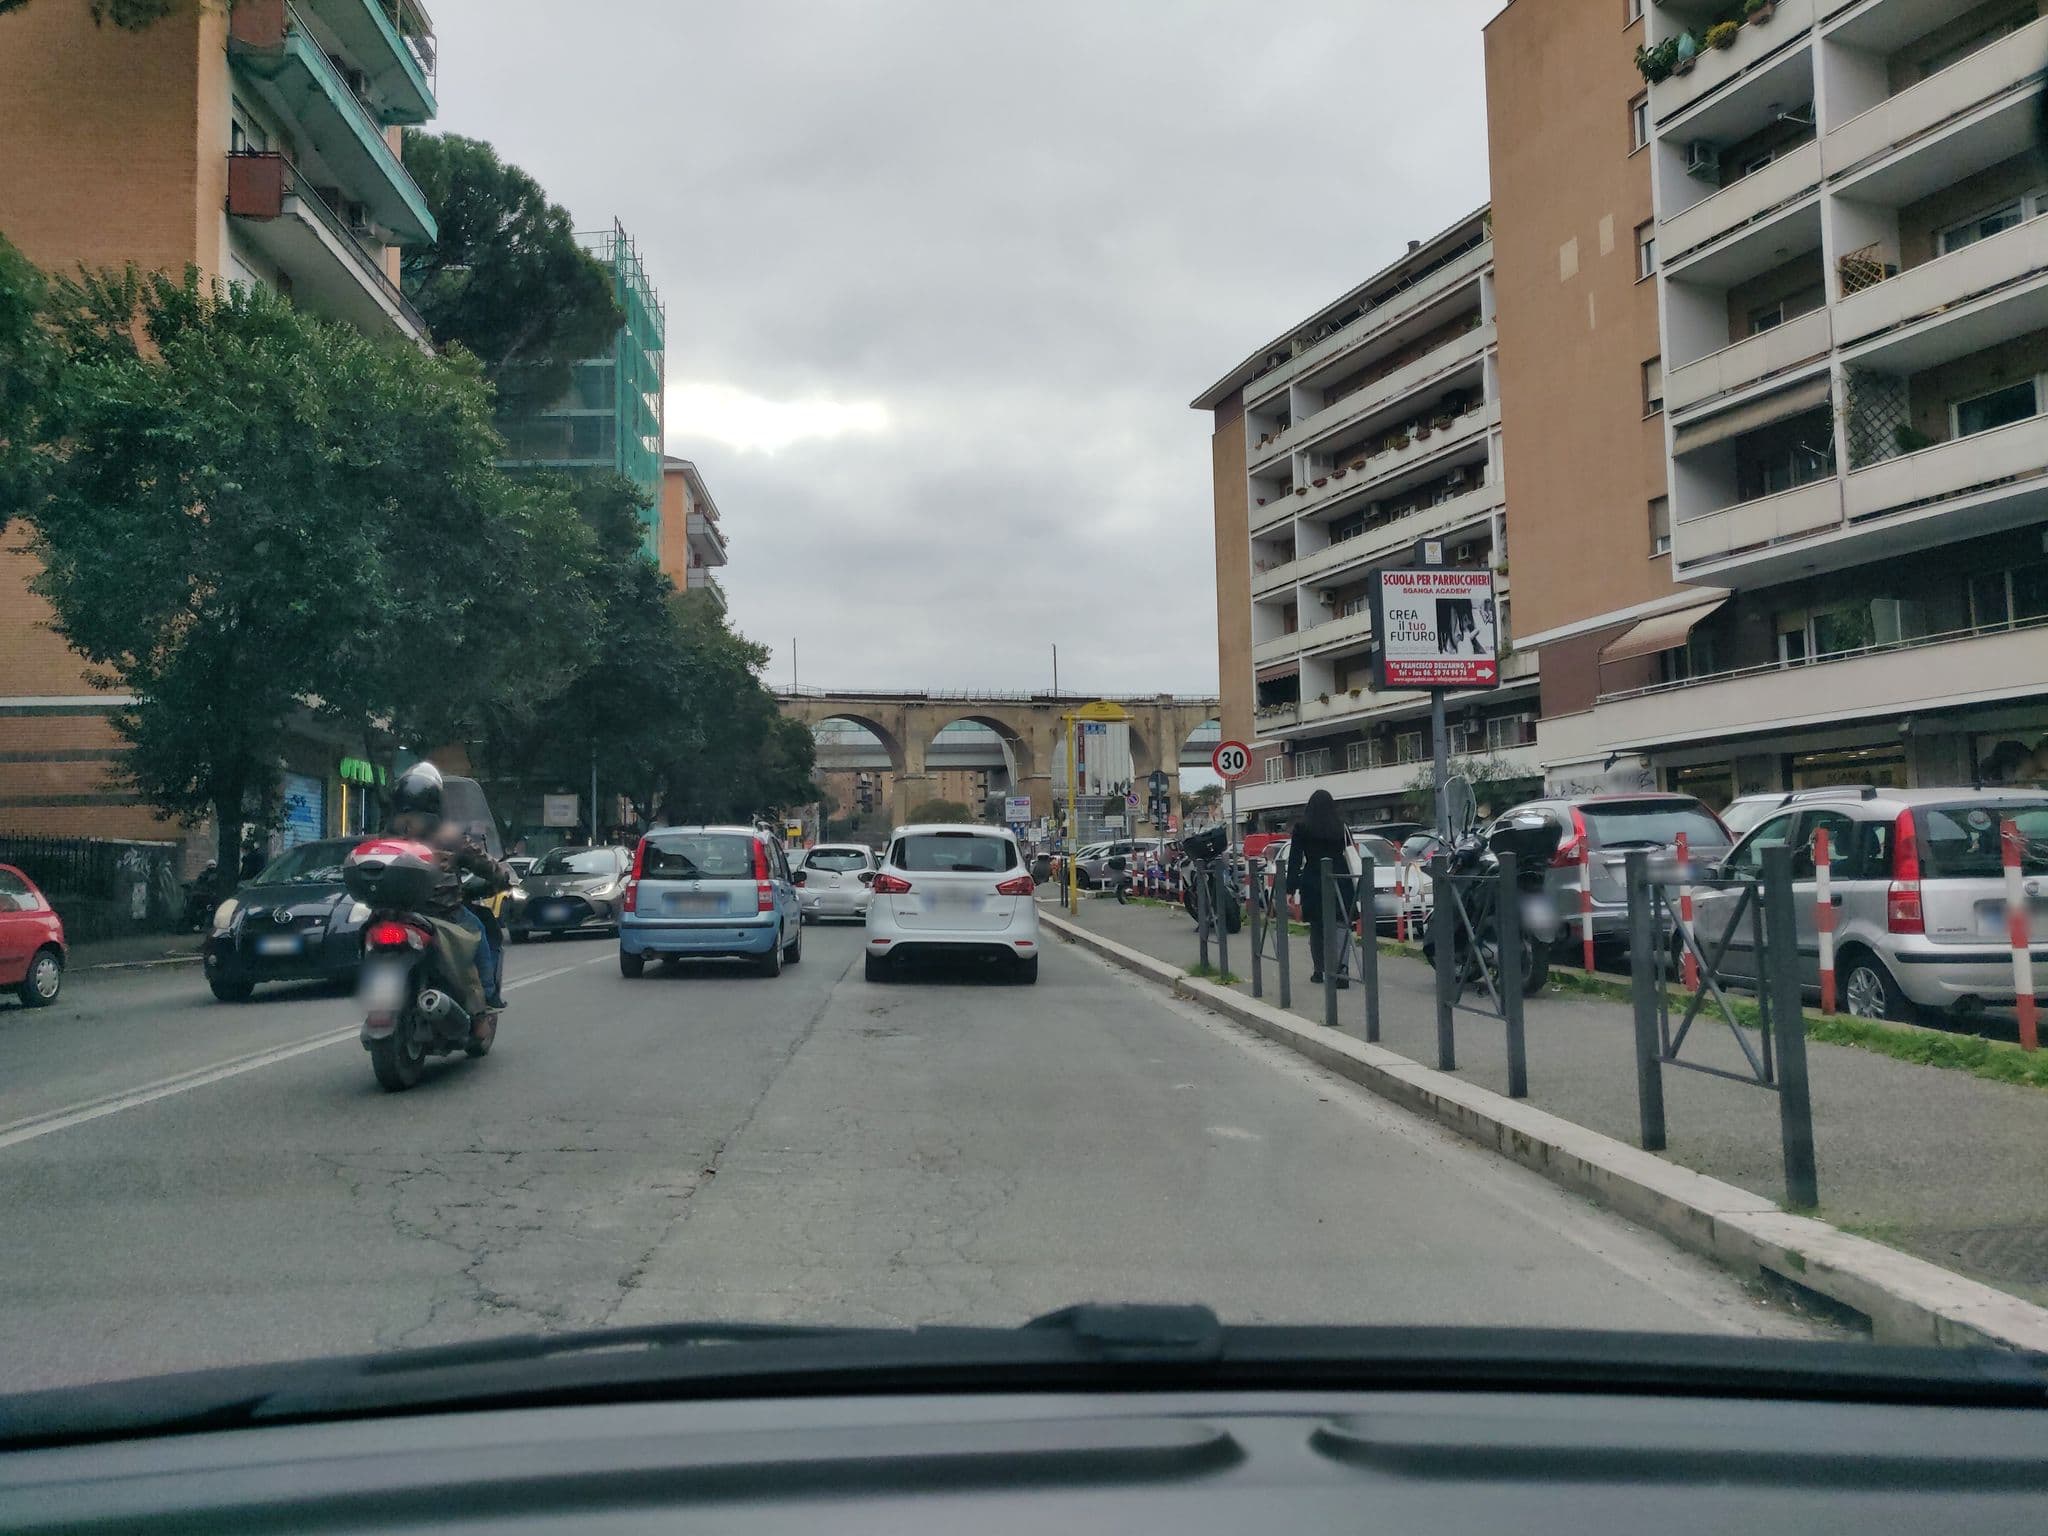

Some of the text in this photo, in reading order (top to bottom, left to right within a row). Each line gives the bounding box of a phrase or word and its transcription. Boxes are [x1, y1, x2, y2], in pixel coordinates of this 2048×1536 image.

[1383, 574, 1490, 587] SCUOLA PER PARRUCCHIERI
[1389, 609, 1418, 620] CREA
[1399, 620, 1427, 631] il tuo
[1390, 631, 1436, 642] FUTURO
[1222, 751, 1244, 770] 30
